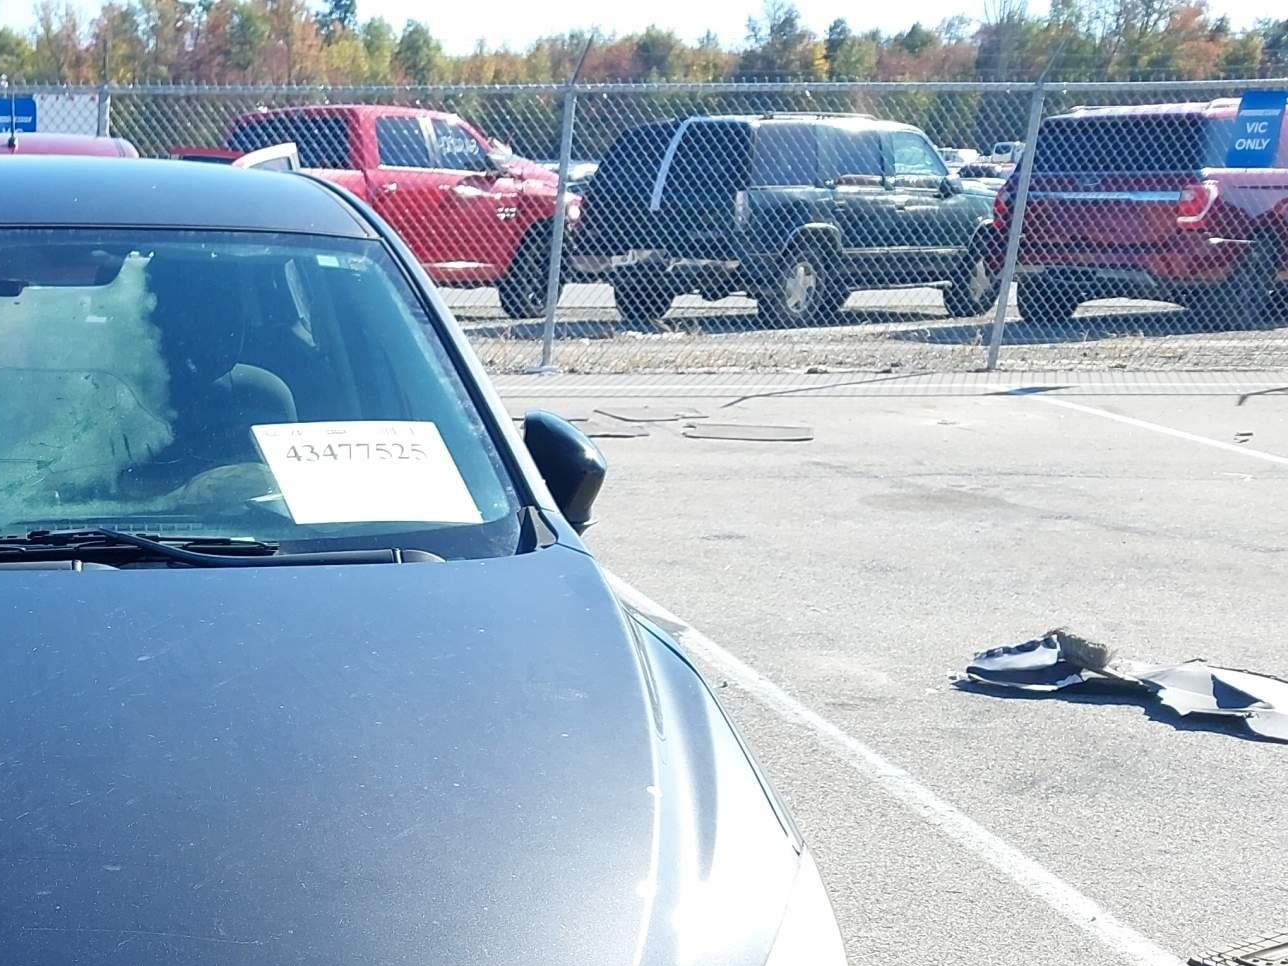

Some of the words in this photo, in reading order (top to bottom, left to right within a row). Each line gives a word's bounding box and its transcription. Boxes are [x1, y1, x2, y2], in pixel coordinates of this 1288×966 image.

[1246, 121, 1269, 133] VIC
[1235, 138, 1271, 151] ONLY
[285, 442, 428, 463] 43477525
